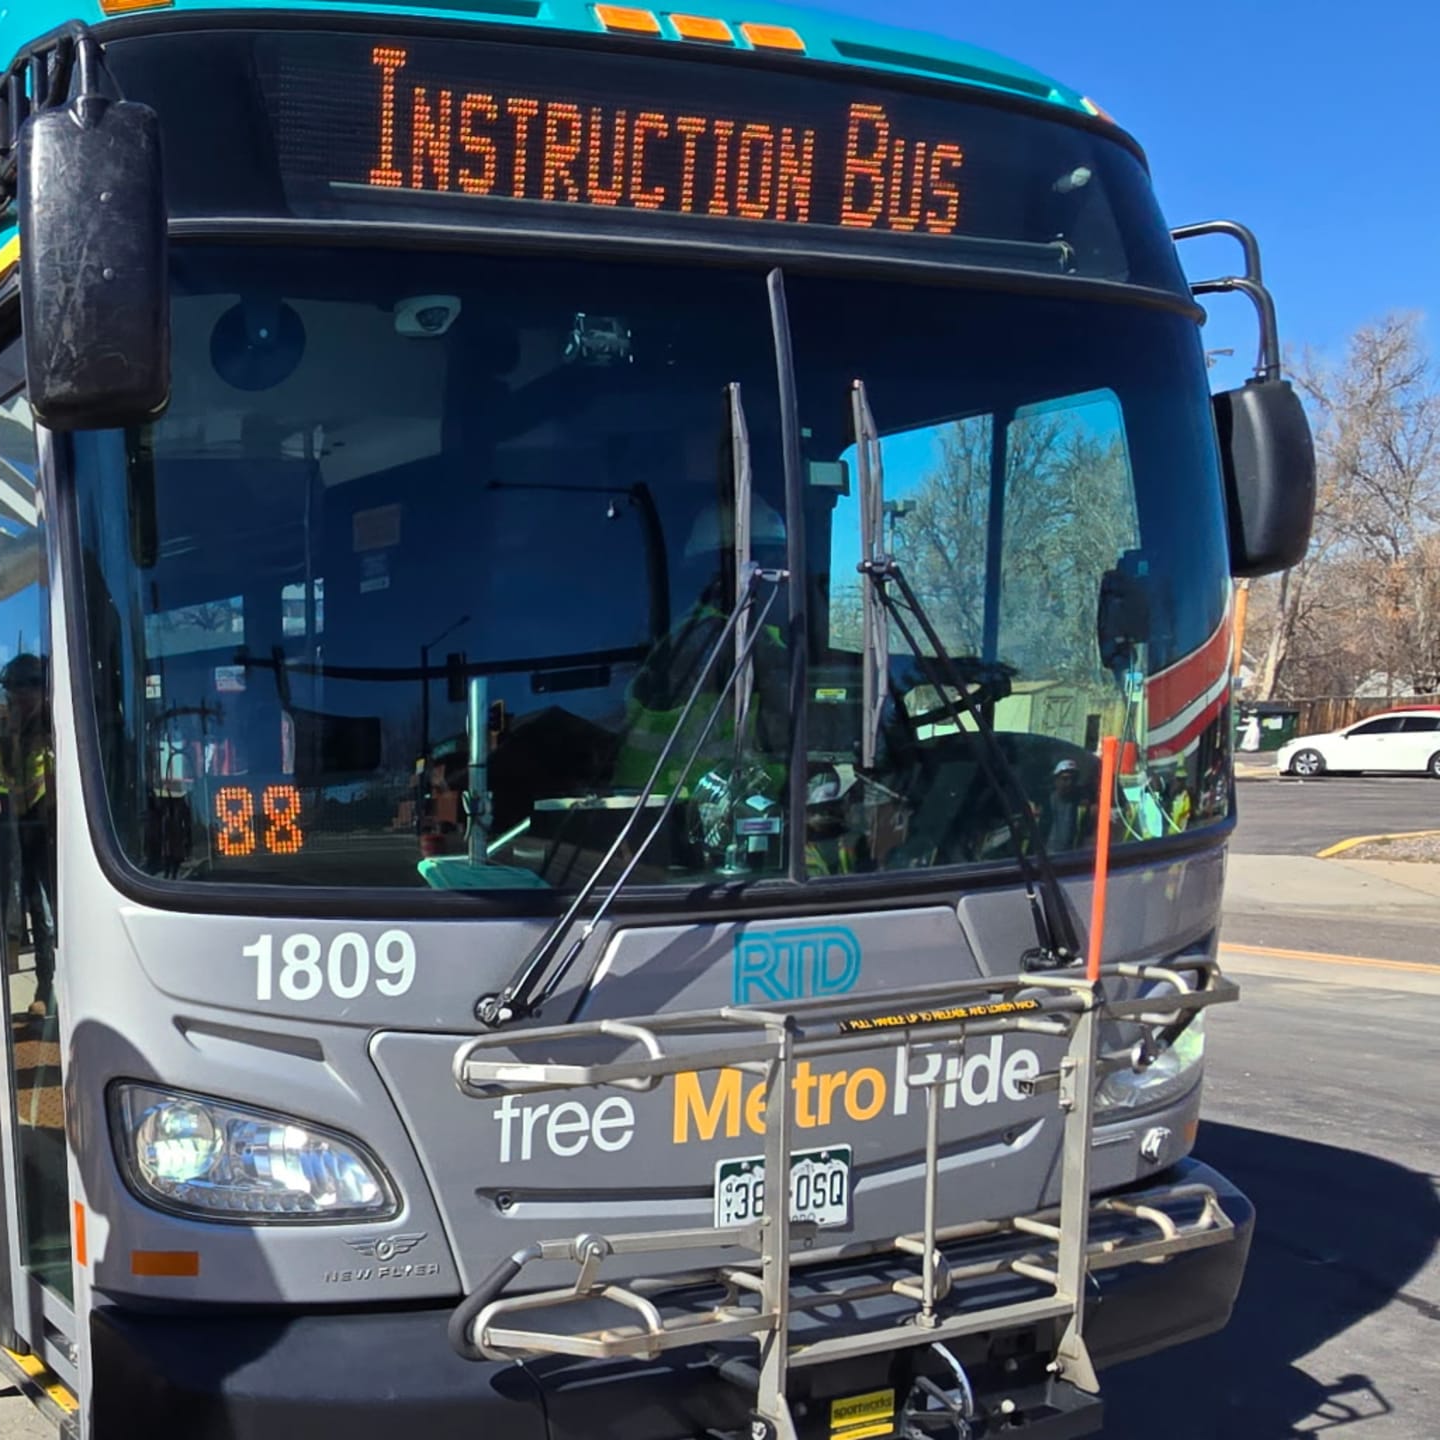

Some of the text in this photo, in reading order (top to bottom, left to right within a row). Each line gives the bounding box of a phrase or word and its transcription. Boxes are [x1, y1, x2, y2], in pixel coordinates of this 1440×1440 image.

[215, 785, 303, 856] 88
[242, 928, 417, 1002] 1809
[733, 926, 862, 1005] RTD
[493, 1094, 635, 1163] free
